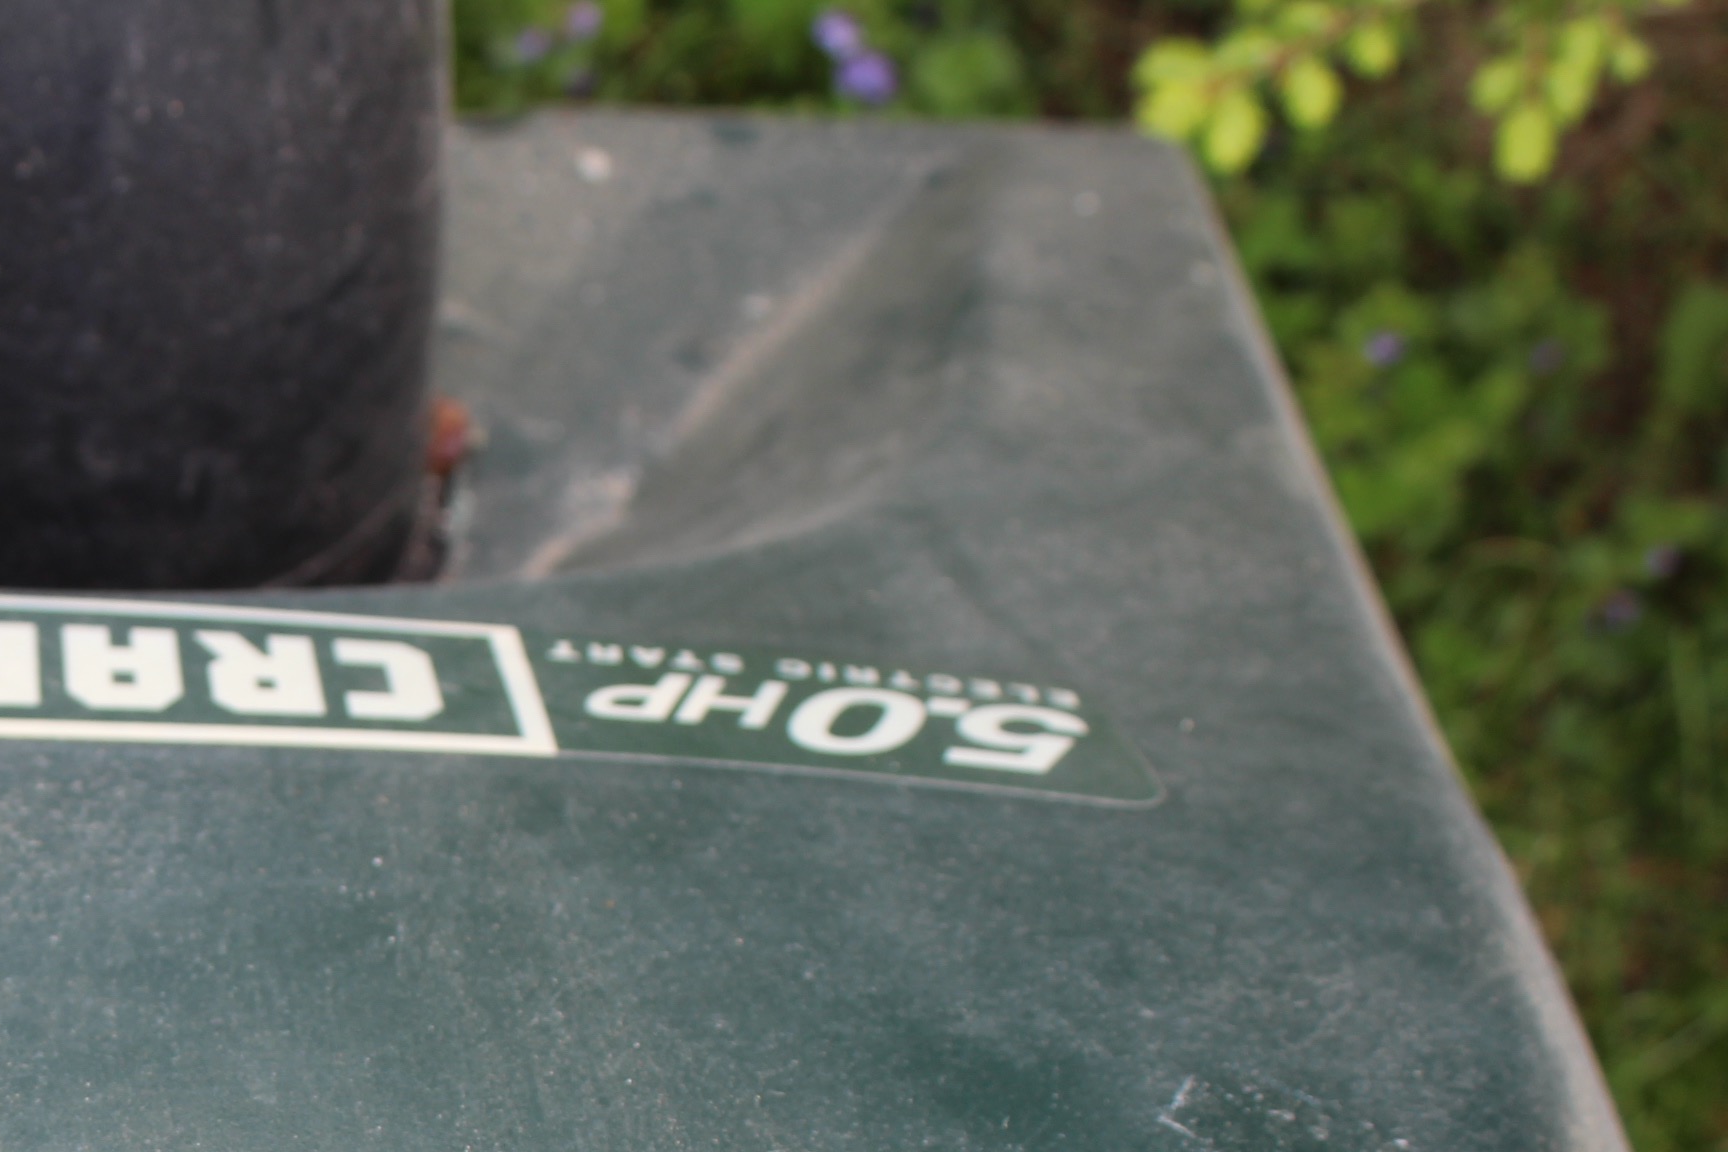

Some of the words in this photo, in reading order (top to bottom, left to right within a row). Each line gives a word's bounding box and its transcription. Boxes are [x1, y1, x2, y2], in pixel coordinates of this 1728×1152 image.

[546, 638, 745, 675] START
[775, 658, 1080, 709] ELECTRIC
[584, 672, 789, 729] HP
[788, 686, 1088, 774] 5.0
